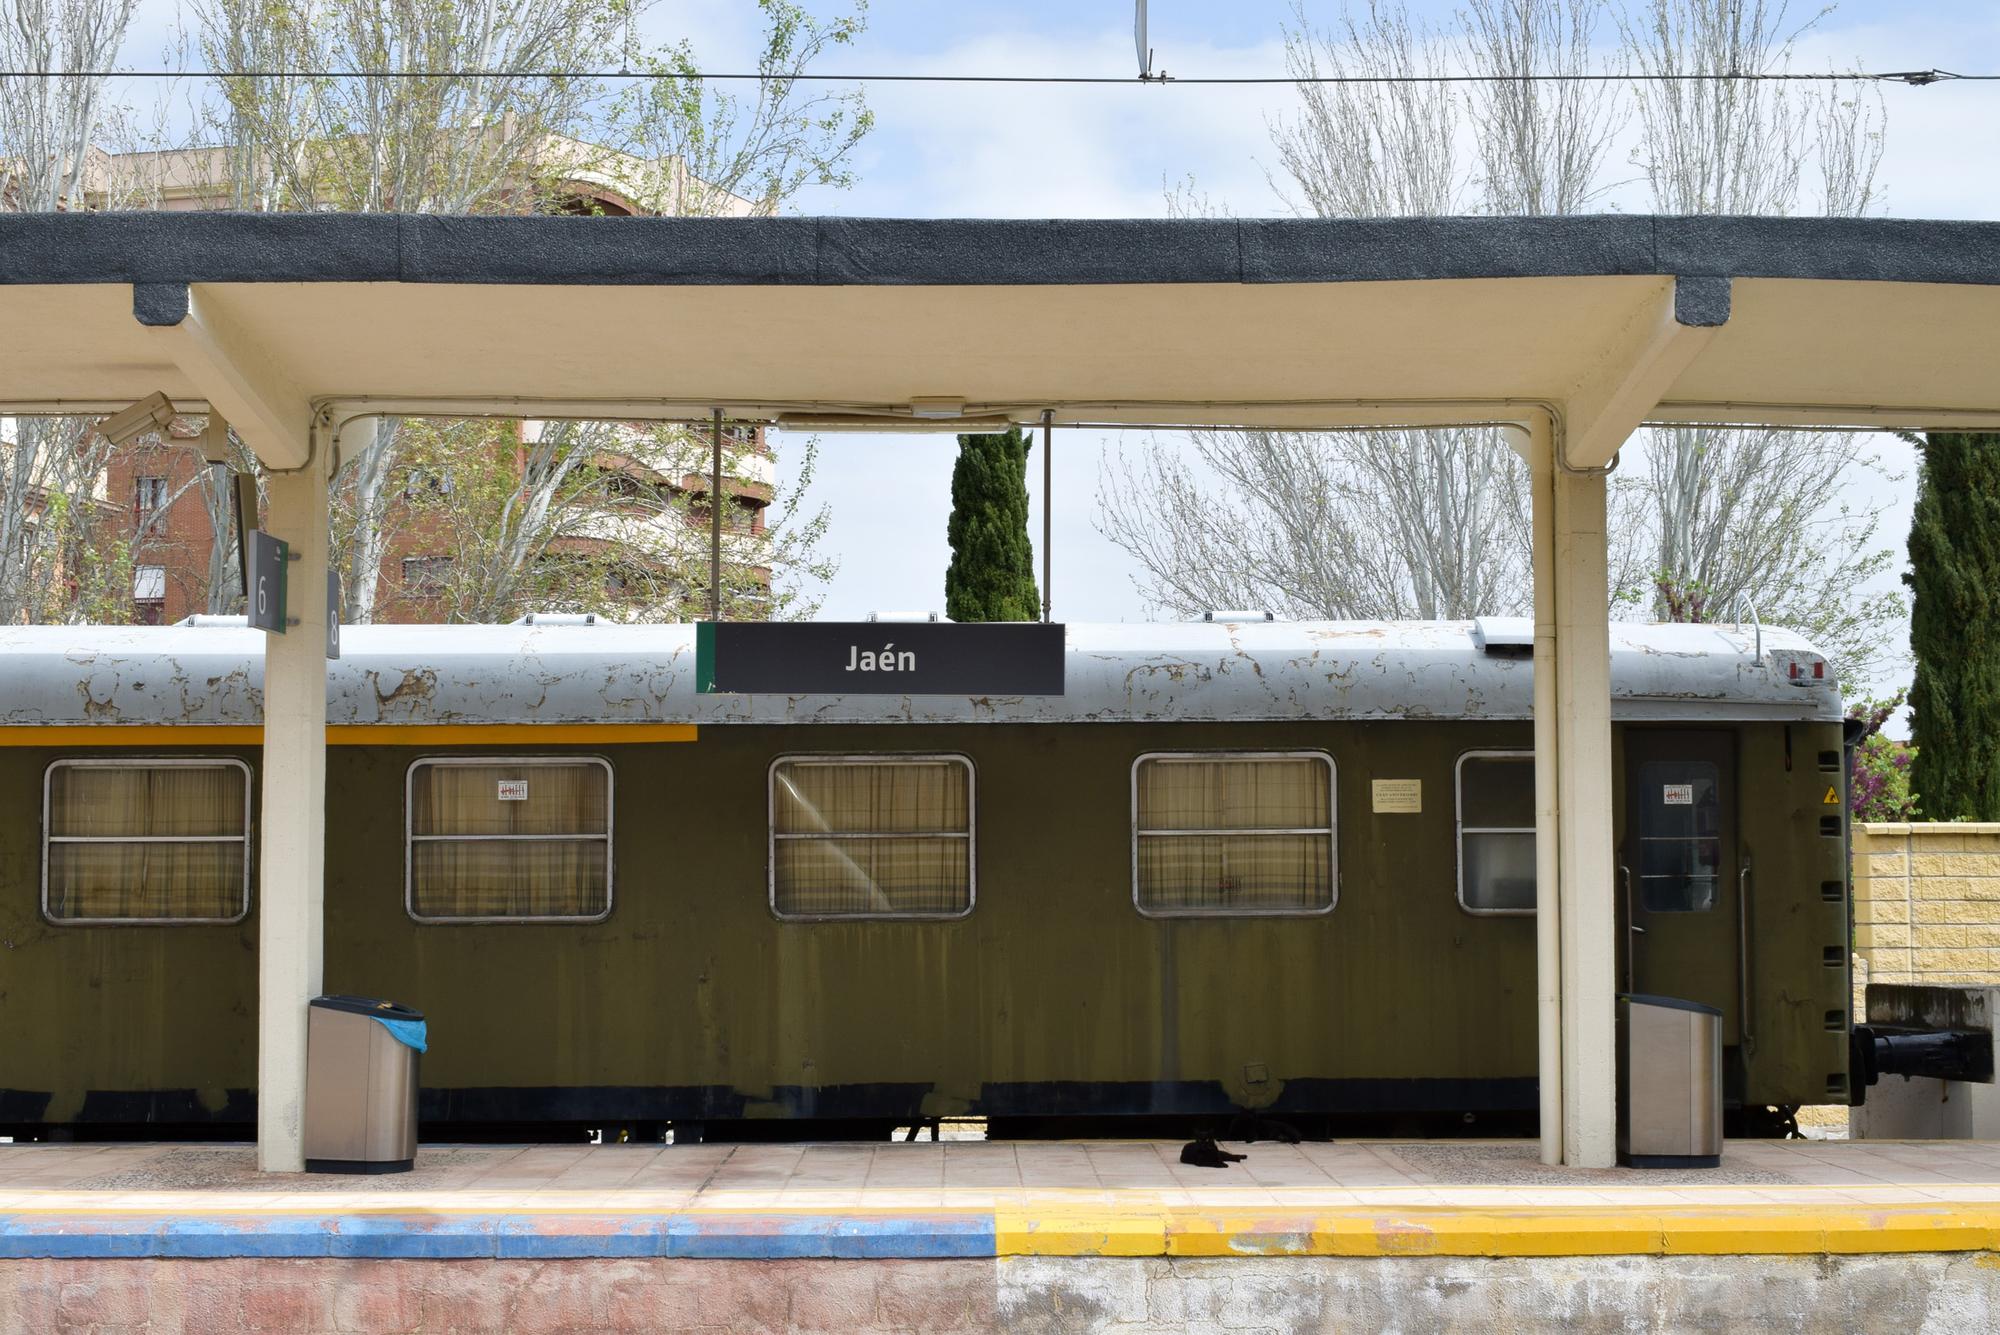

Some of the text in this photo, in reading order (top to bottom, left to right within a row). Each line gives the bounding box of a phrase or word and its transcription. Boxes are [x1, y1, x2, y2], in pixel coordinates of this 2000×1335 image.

[258, 575, 267, 615] 6
[331, 610, 338, 646] 8
[845, 643, 916, 671] Jaén
